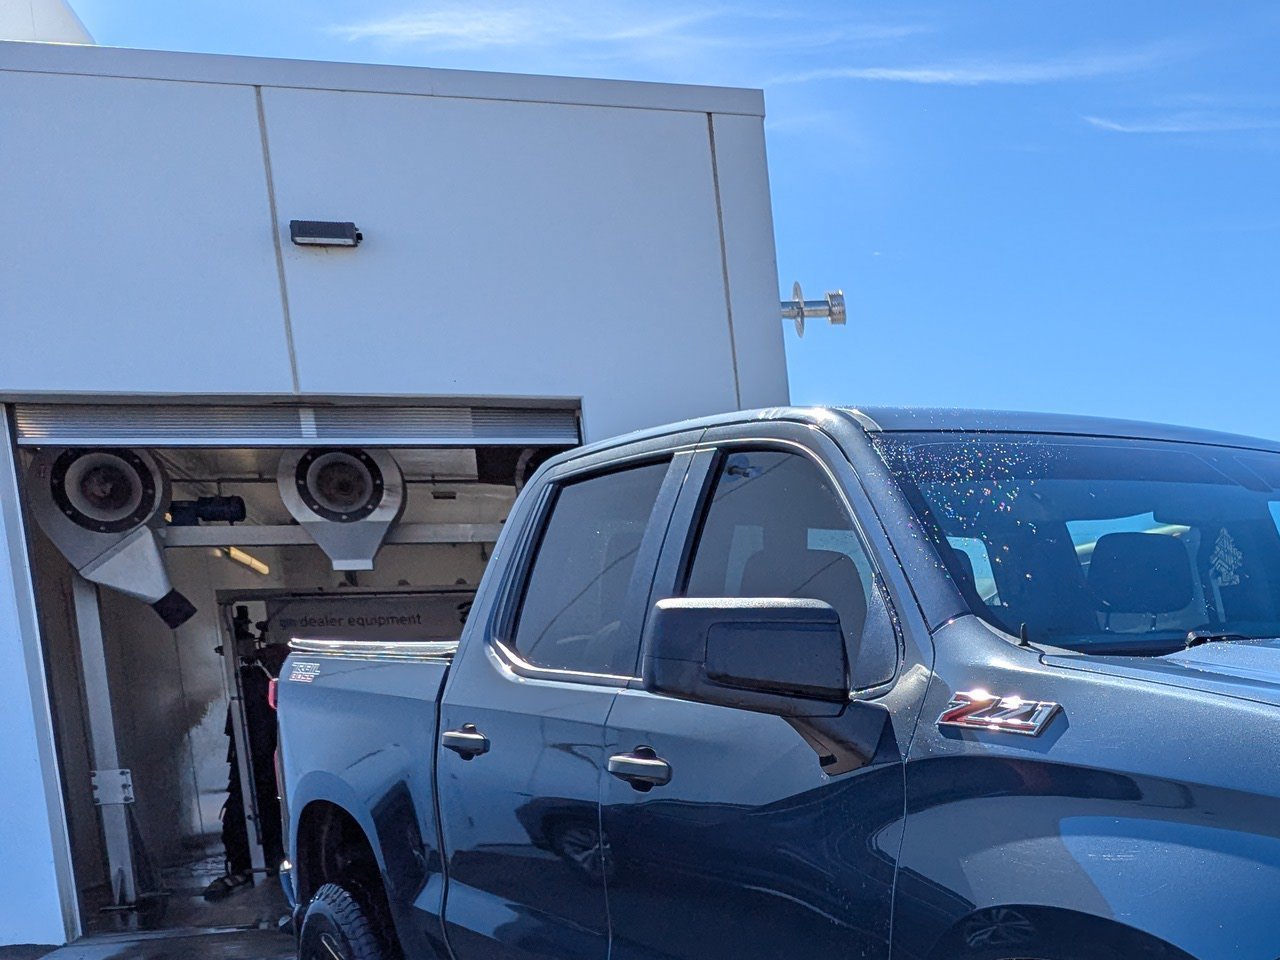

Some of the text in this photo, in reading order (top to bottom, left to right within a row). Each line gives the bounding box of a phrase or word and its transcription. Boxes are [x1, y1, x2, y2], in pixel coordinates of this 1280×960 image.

[299, 615, 344, 627] dealer
[347, 613, 422, 628] equipment
[291, 661, 321, 675] TRAIL
[935, 688, 1061, 737] Z71
